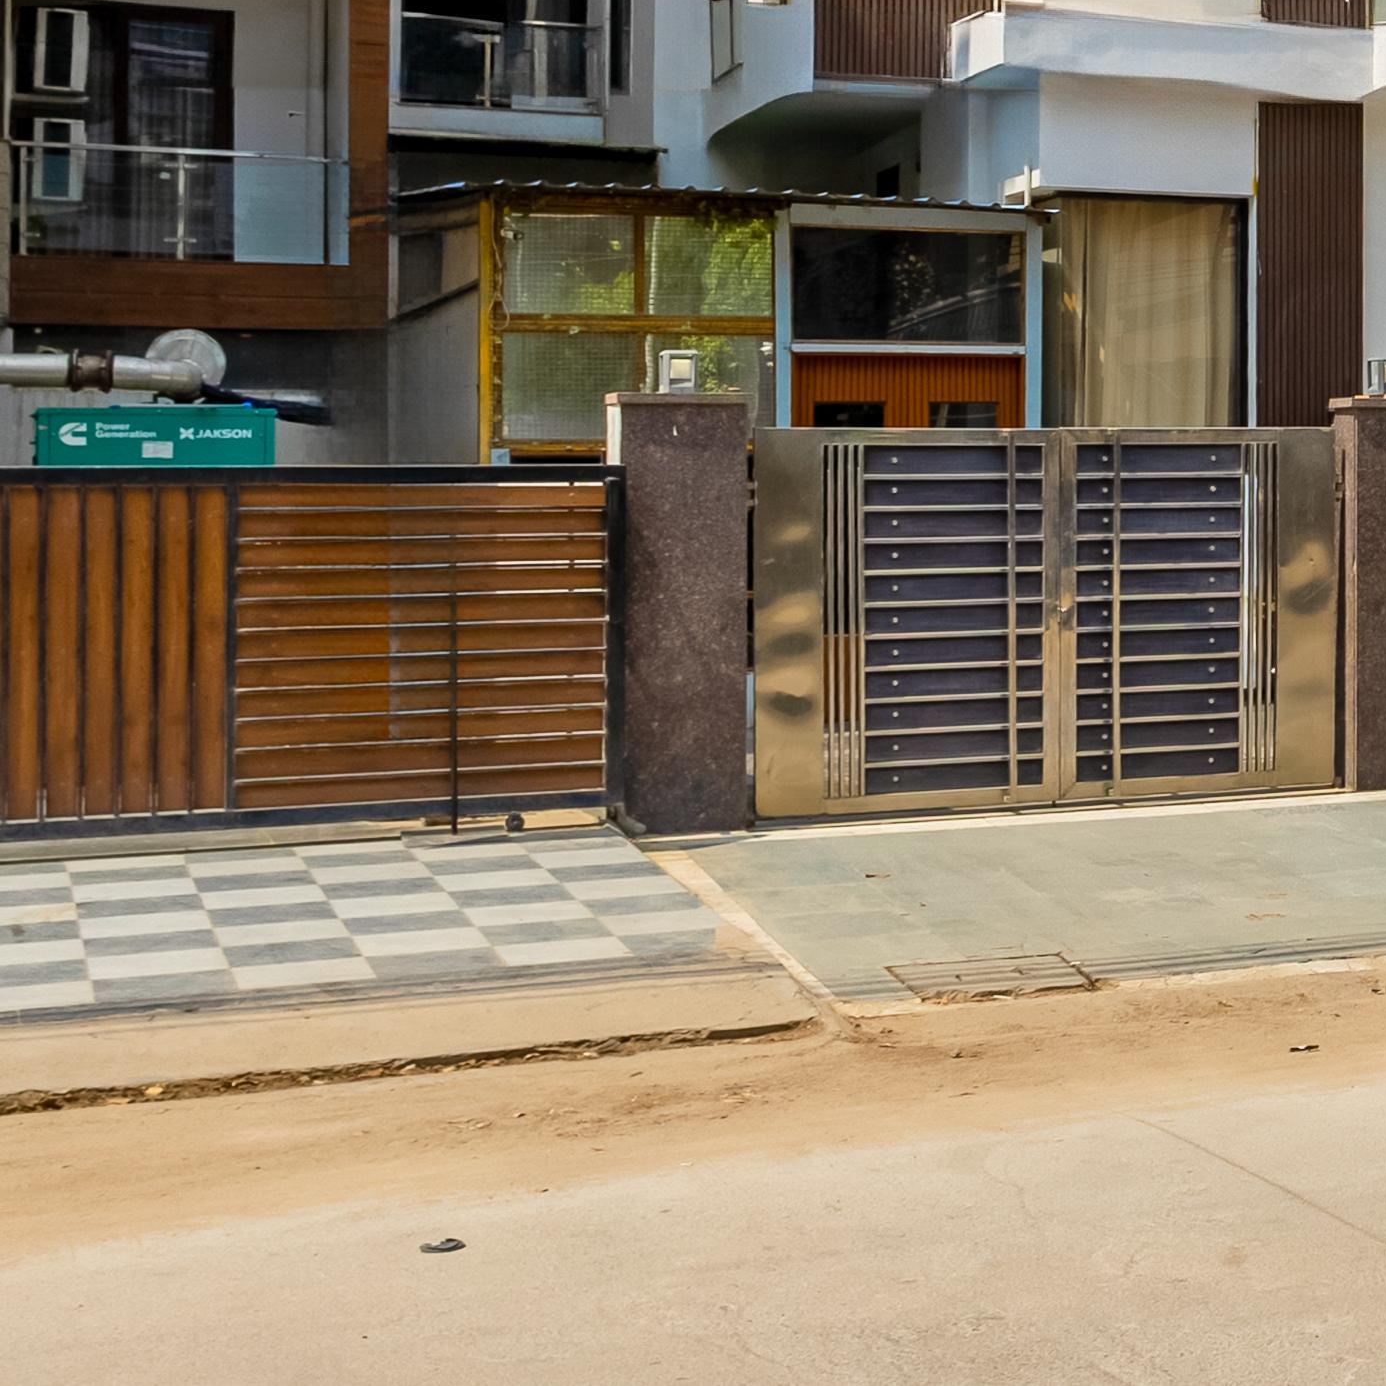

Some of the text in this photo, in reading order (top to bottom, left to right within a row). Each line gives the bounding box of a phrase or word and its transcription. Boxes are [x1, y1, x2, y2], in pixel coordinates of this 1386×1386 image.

[95, 422, 131, 431] Power
[95, 430, 157, 439] Generation
[196, 428, 252, 439] JAKSON
